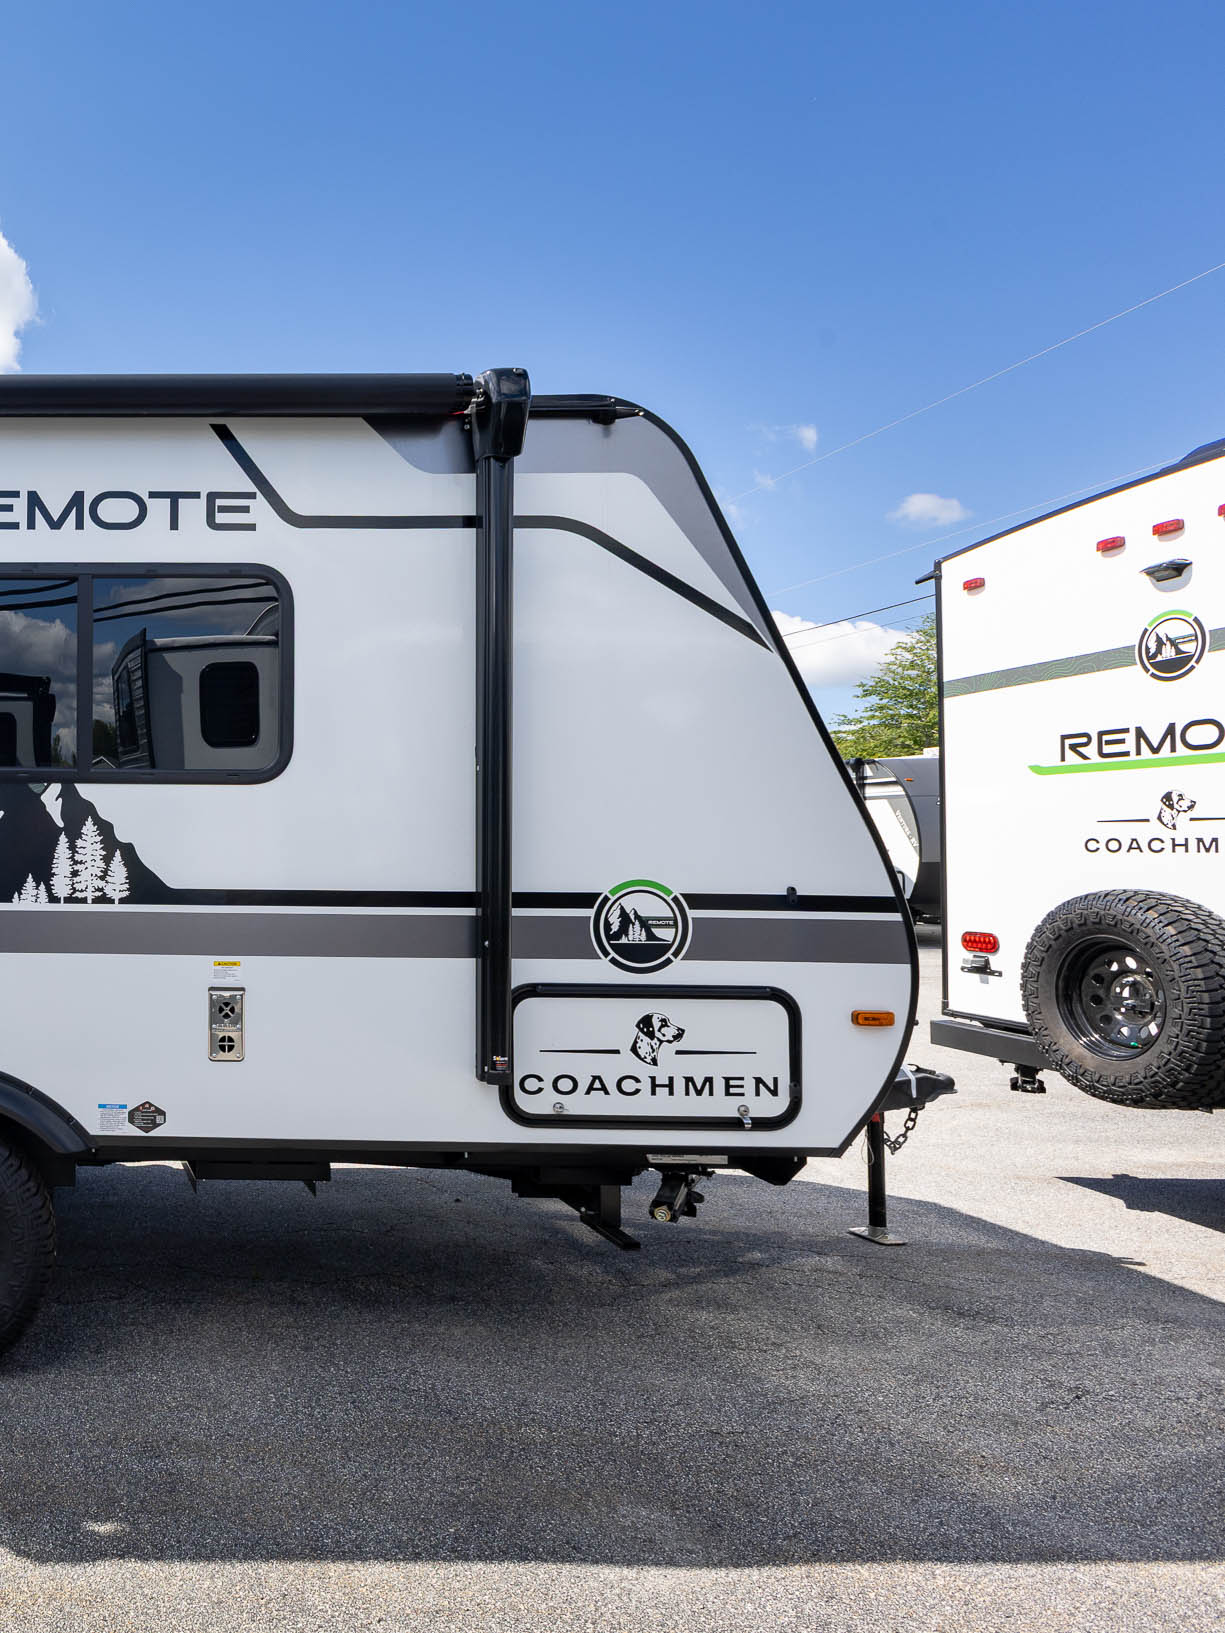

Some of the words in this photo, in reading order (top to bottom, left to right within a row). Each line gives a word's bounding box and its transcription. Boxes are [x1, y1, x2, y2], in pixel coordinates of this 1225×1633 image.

[1060, 718, 1225, 762] REMO
[1084, 837, 1220, 853] COACHM
[518, 1073, 779, 1097] COACHMEN
